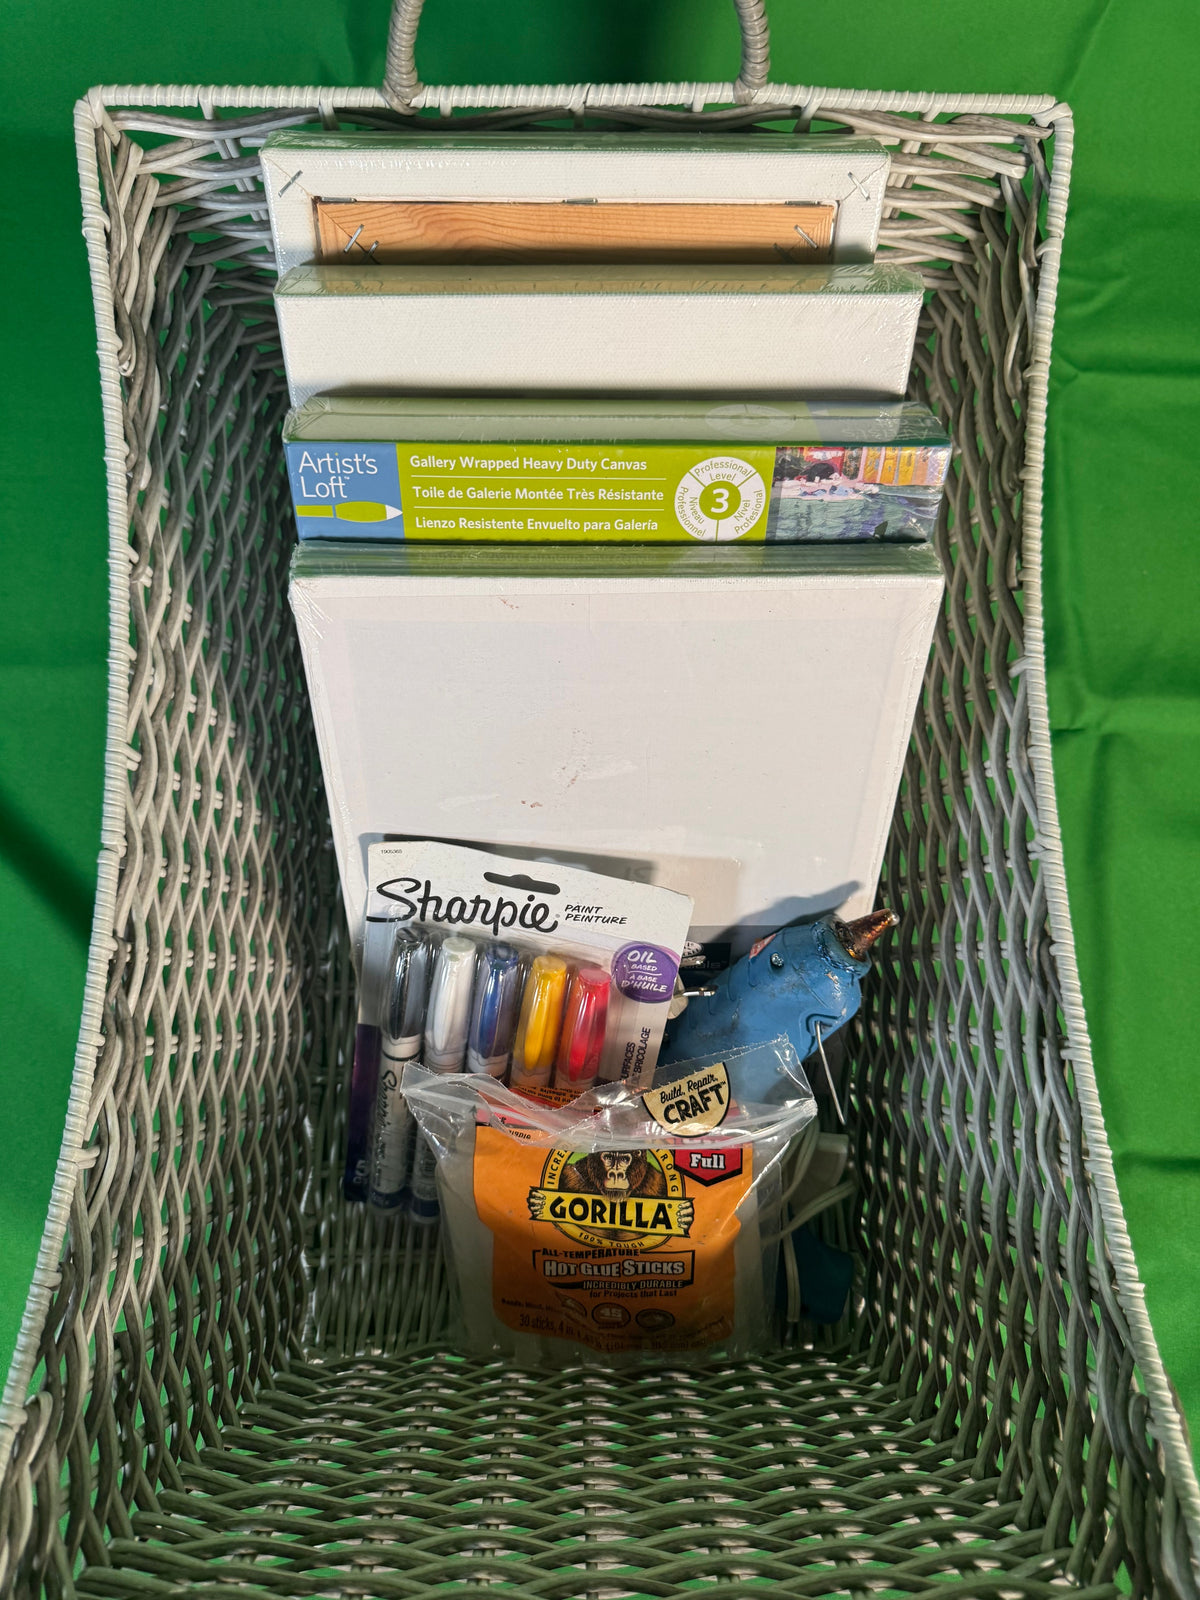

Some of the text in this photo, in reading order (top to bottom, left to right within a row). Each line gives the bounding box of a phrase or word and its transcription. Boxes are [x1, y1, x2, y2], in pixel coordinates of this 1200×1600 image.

[299, 451, 378, 474] Artist's
[409, 455, 647, 472] Gallery Wrapped Heavy Duty Canvas
[694, 460, 753, 477] Professional
[709, 472, 737, 481] Level
[300, 476, 347, 499] Loft
[412, 486, 664, 501] Toile de Galerie Montée Très Résistante
[710, 488, 730, 513] 3
[677, 486, 707, 537] Professionnel
[688, 496, 705, 524] Niveau
[734, 499, 751, 521] Nivel
[415, 516, 659, 534] Lienzo Resistente Envuelto para Galería
[368, 877, 558, 936] Sharpie
[564, 904, 602, 914] PAINT
[564, 913, 628, 925] PEINTURE
[627, 950, 657, 964] OIL
[631, 963, 657, 972] BASED
[621, 980, 668, 993] D'HUILE
[640, 974, 658, 983] BASE
[633, 1027, 651, 1074] BRICOLAGE
[621, 1041, 636, 1080] URFACES
[689, 1153, 726, 1170] Full
[547, 1149, 679, 1192] INCRE RONG
[549, 1196, 673, 1230] GORILLA
[579, 1232, 645, 1249] 100% TOUGH
[542, 1247, 640, 1260] ALL-TEMPERATURE
[583, 1279, 684, 1291] INCREDIBLY DURABLE
[589, 1289, 677, 1299] for Projects that Last
